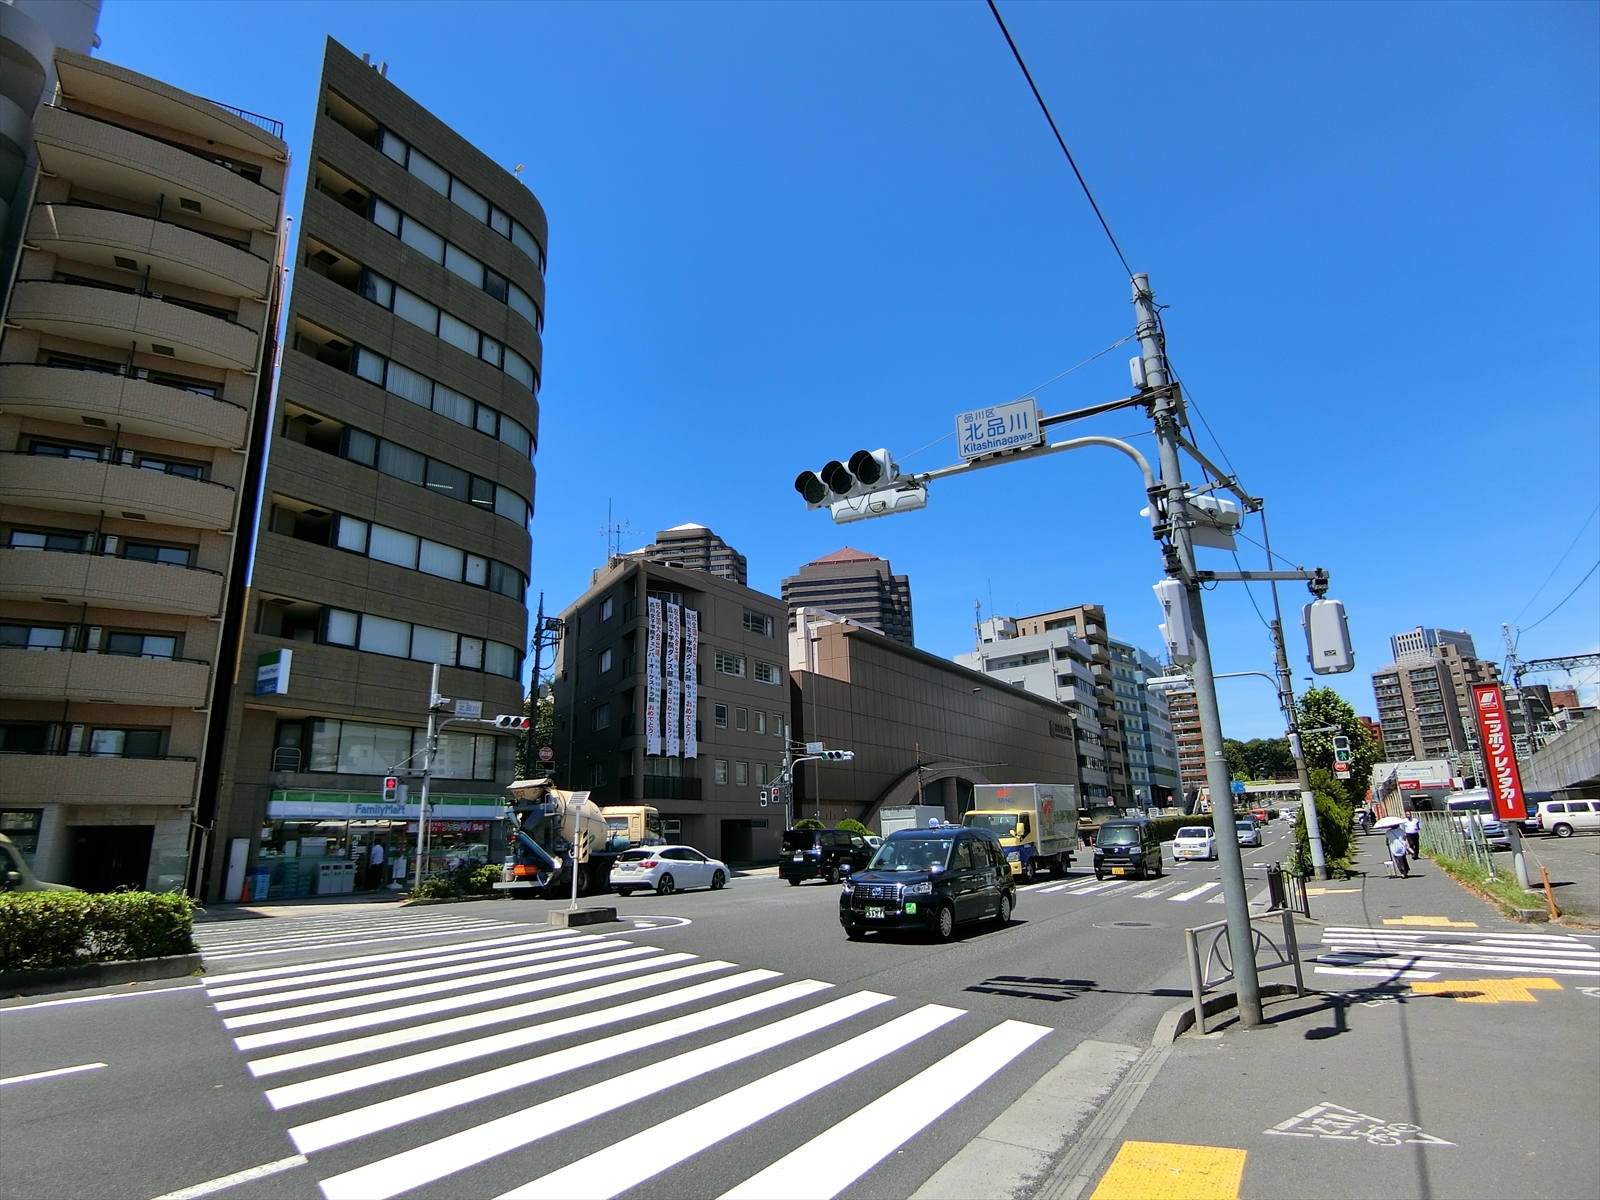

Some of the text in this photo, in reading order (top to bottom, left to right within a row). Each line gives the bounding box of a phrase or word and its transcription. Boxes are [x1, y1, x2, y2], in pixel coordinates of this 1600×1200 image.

[964, 408, 995, 424] 品川区
[965, 411, 1028, 441] 北品川
[963, 432, 1034, 454] Kitashinagawa
[1484, 712, 1516, 810] ニッポンレンタカー
[355, 803, 406, 816] FamilyMart
